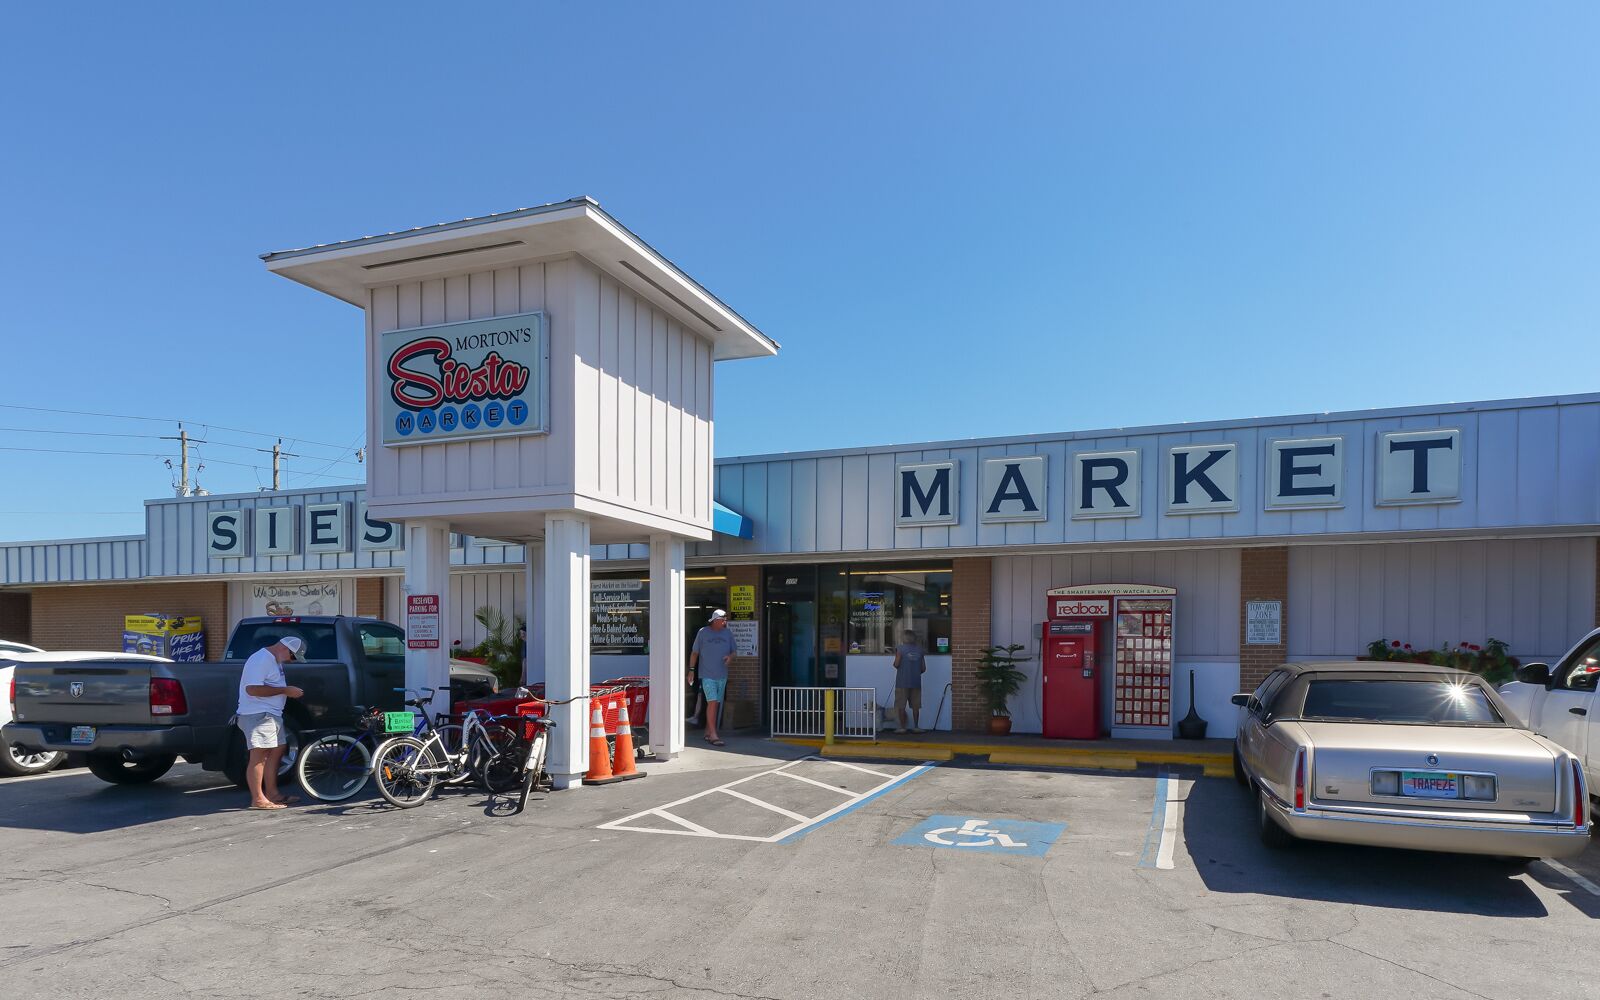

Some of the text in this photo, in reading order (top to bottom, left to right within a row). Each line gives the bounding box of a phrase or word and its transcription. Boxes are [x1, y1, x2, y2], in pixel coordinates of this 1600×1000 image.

[456, 327, 531, 351] MORTON'S
[387, 337, 530, 411] Siesta
[399, 406, 523, 430] MARKET
[901, 435, 1453, 518] MARKET
[413, 596, 434, 604] RESERVED
[409, 604, 438, 612] PARKING FOR
[1255, 610, 1273, 619] ZONE
[170, 631, 203, 647] GRILL
[622, 634, 644, 644] Selection
[171, 644, 194, 656] LIKE
[1411, 777, 1456, 791] TRAPEZE
